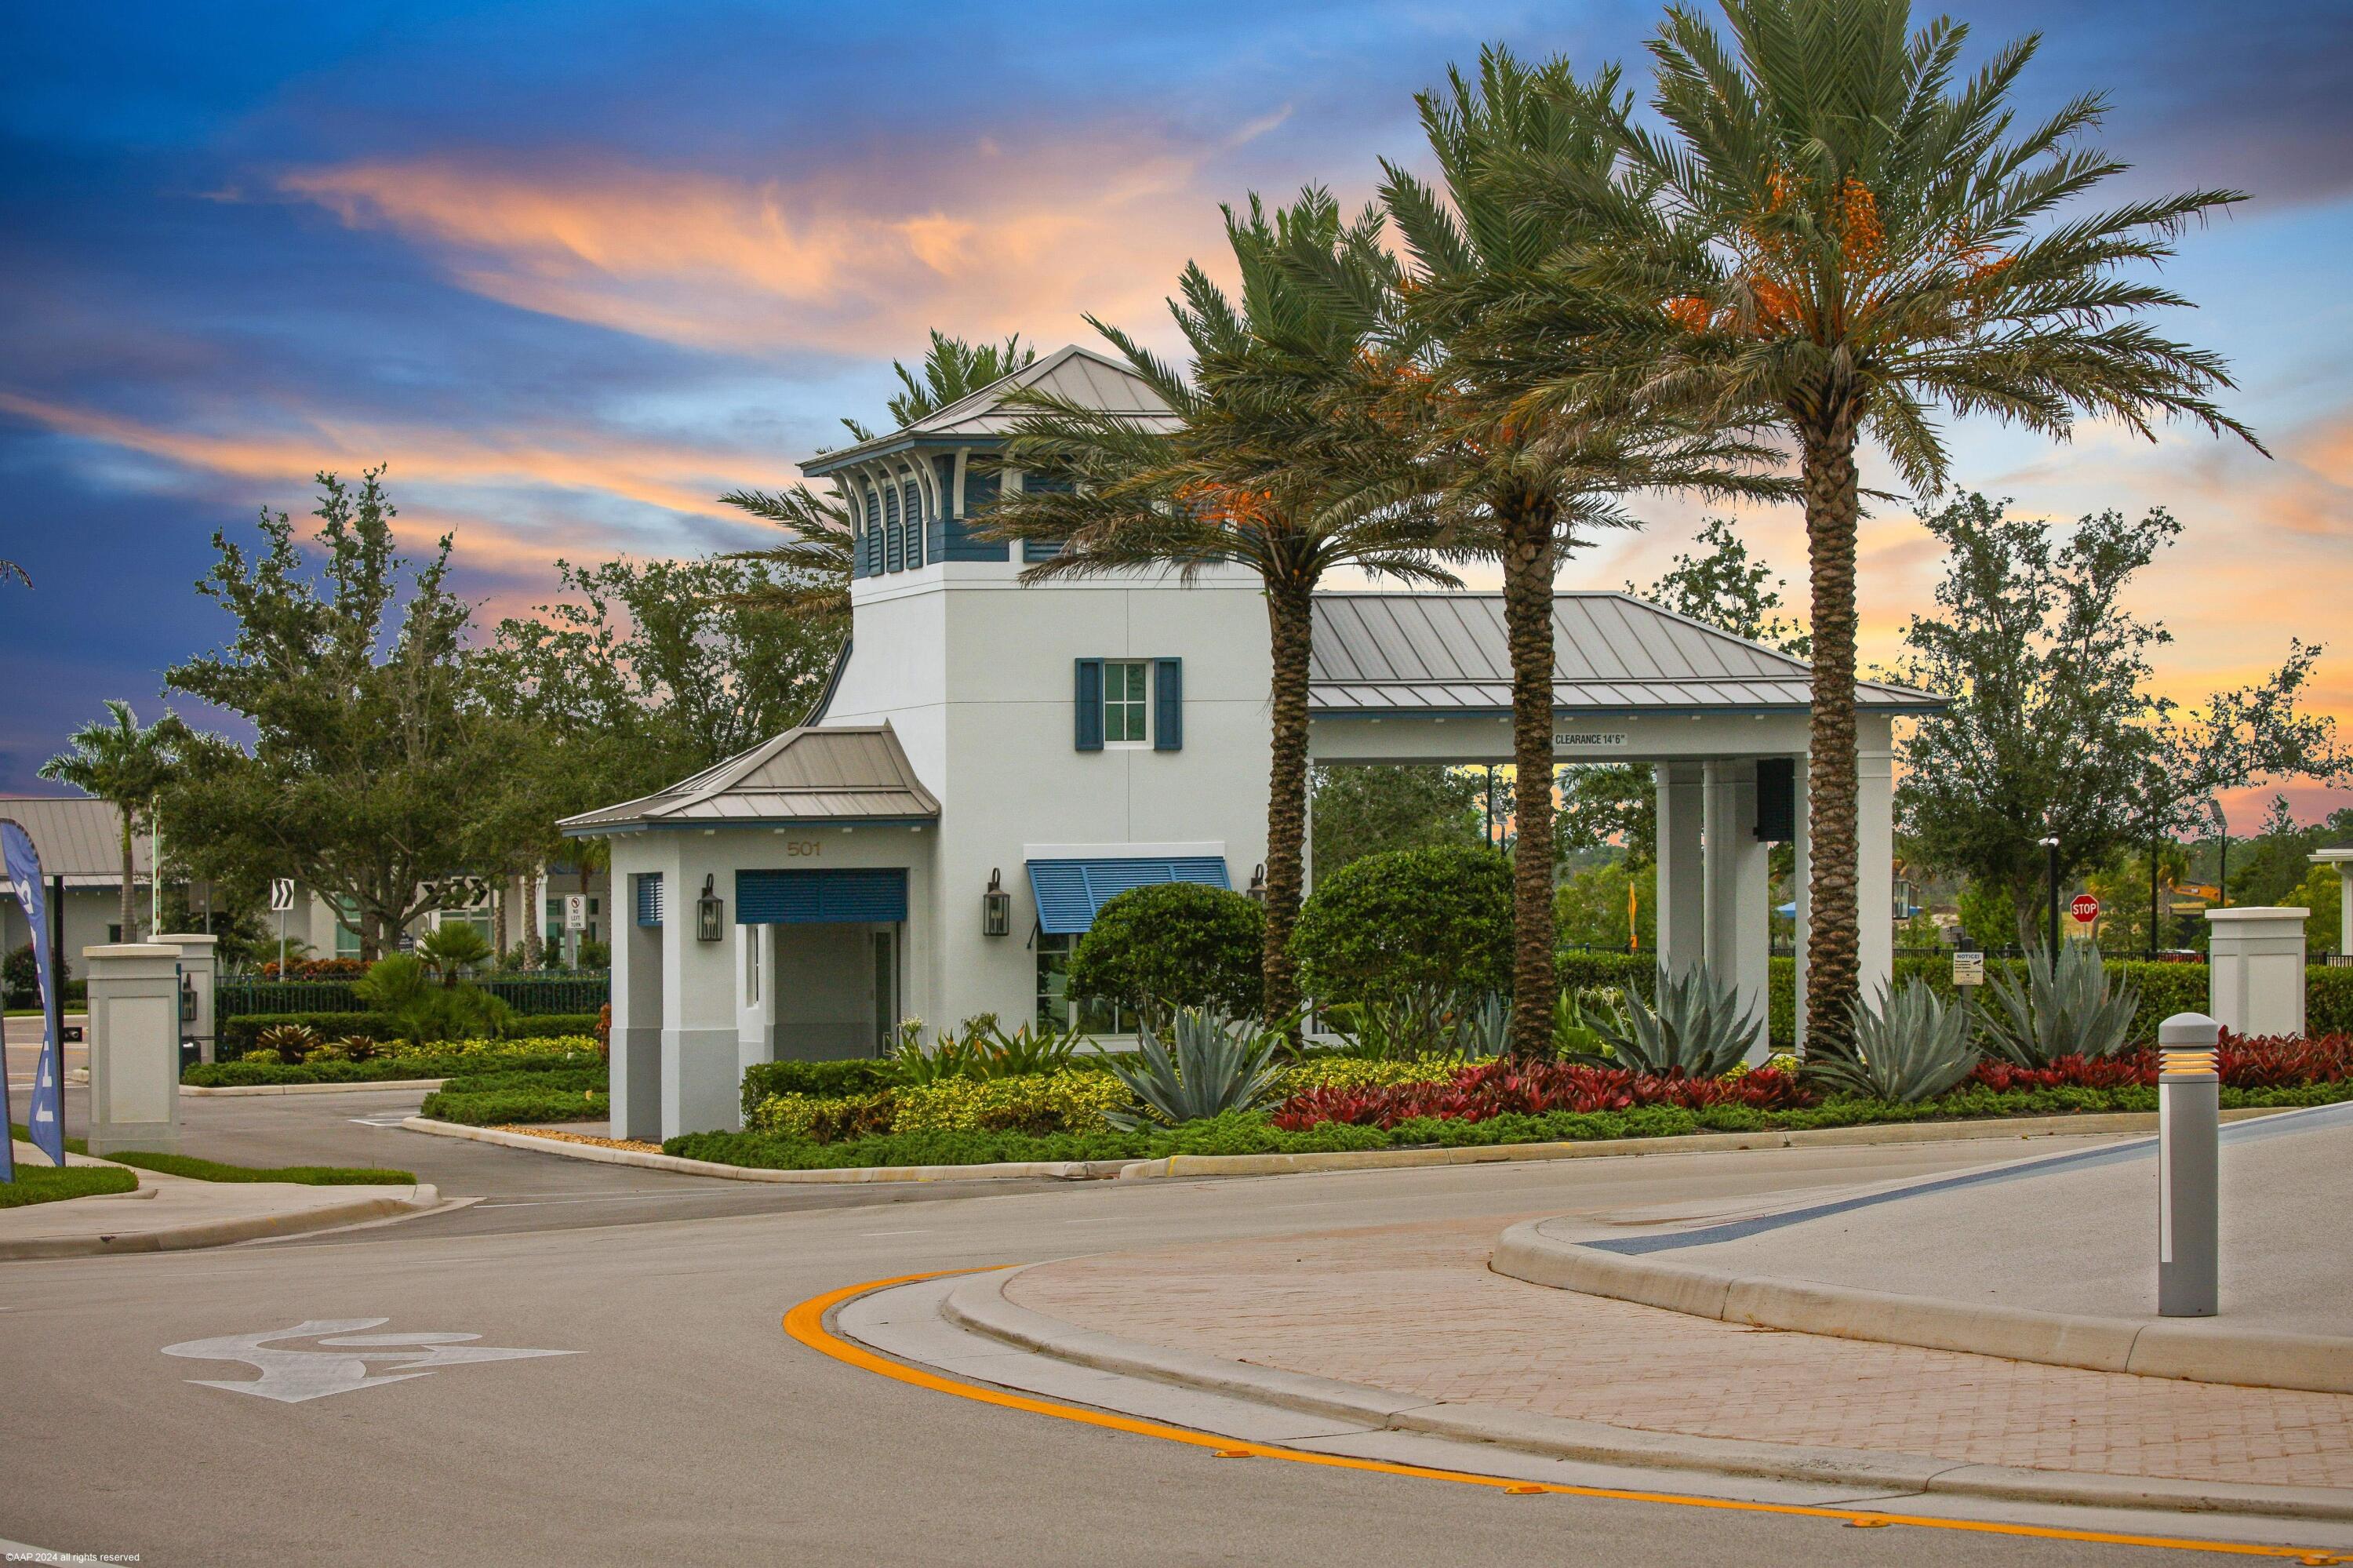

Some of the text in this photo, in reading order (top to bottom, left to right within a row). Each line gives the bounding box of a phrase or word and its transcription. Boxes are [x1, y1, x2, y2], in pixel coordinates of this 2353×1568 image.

[1555, 734, 1602, 744] CLEARANCE
[787, 841, 820, 856] 501
[2072, 903, 2097, 915] STOP
